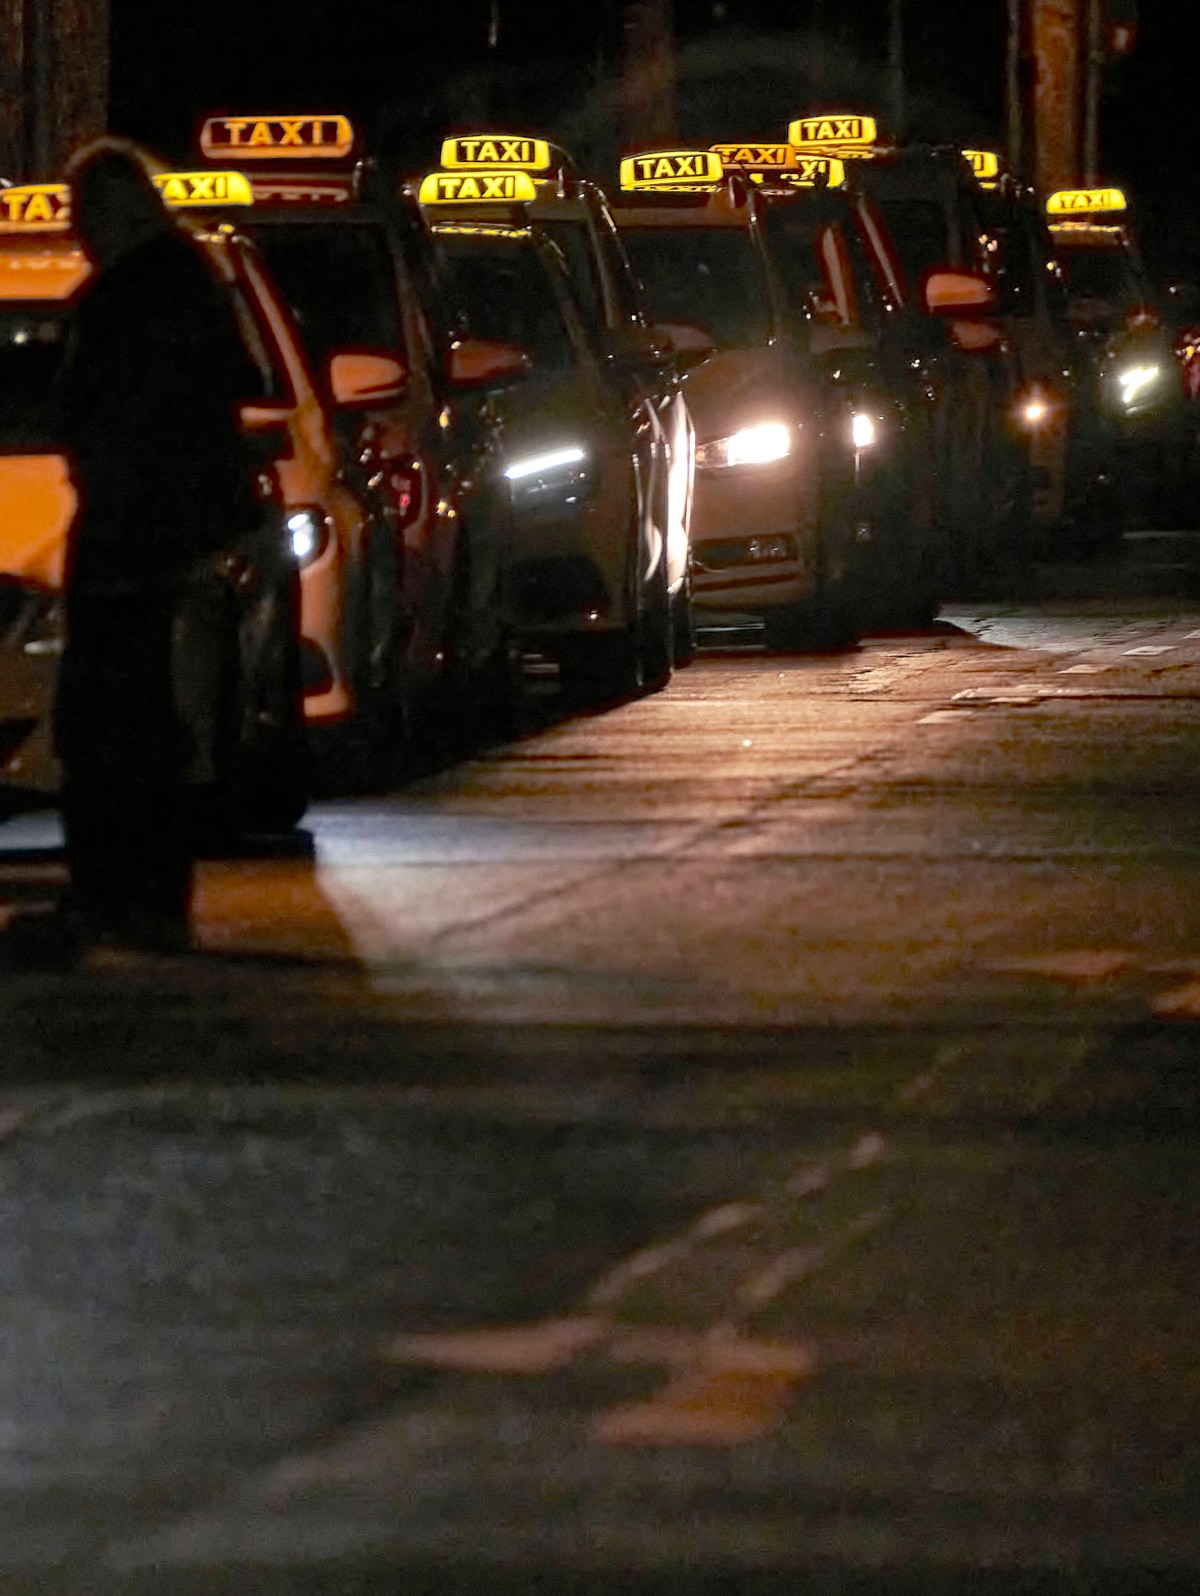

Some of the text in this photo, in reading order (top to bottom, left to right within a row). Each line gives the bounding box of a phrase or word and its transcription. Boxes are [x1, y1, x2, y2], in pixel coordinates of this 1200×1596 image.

[224, 121, 322, 145] TAXI
[803, 119, 860, 140] TAXI
[460, 141, 530, 162] TAXI
[717, 148, 785, 164] TAXI
[637, 155, 704, 179] TAXI
[154, 176, 228, 199] AXI
[439, 176, 515, 199] TAXI
[1062, 192, 1107, 209] TAXI
